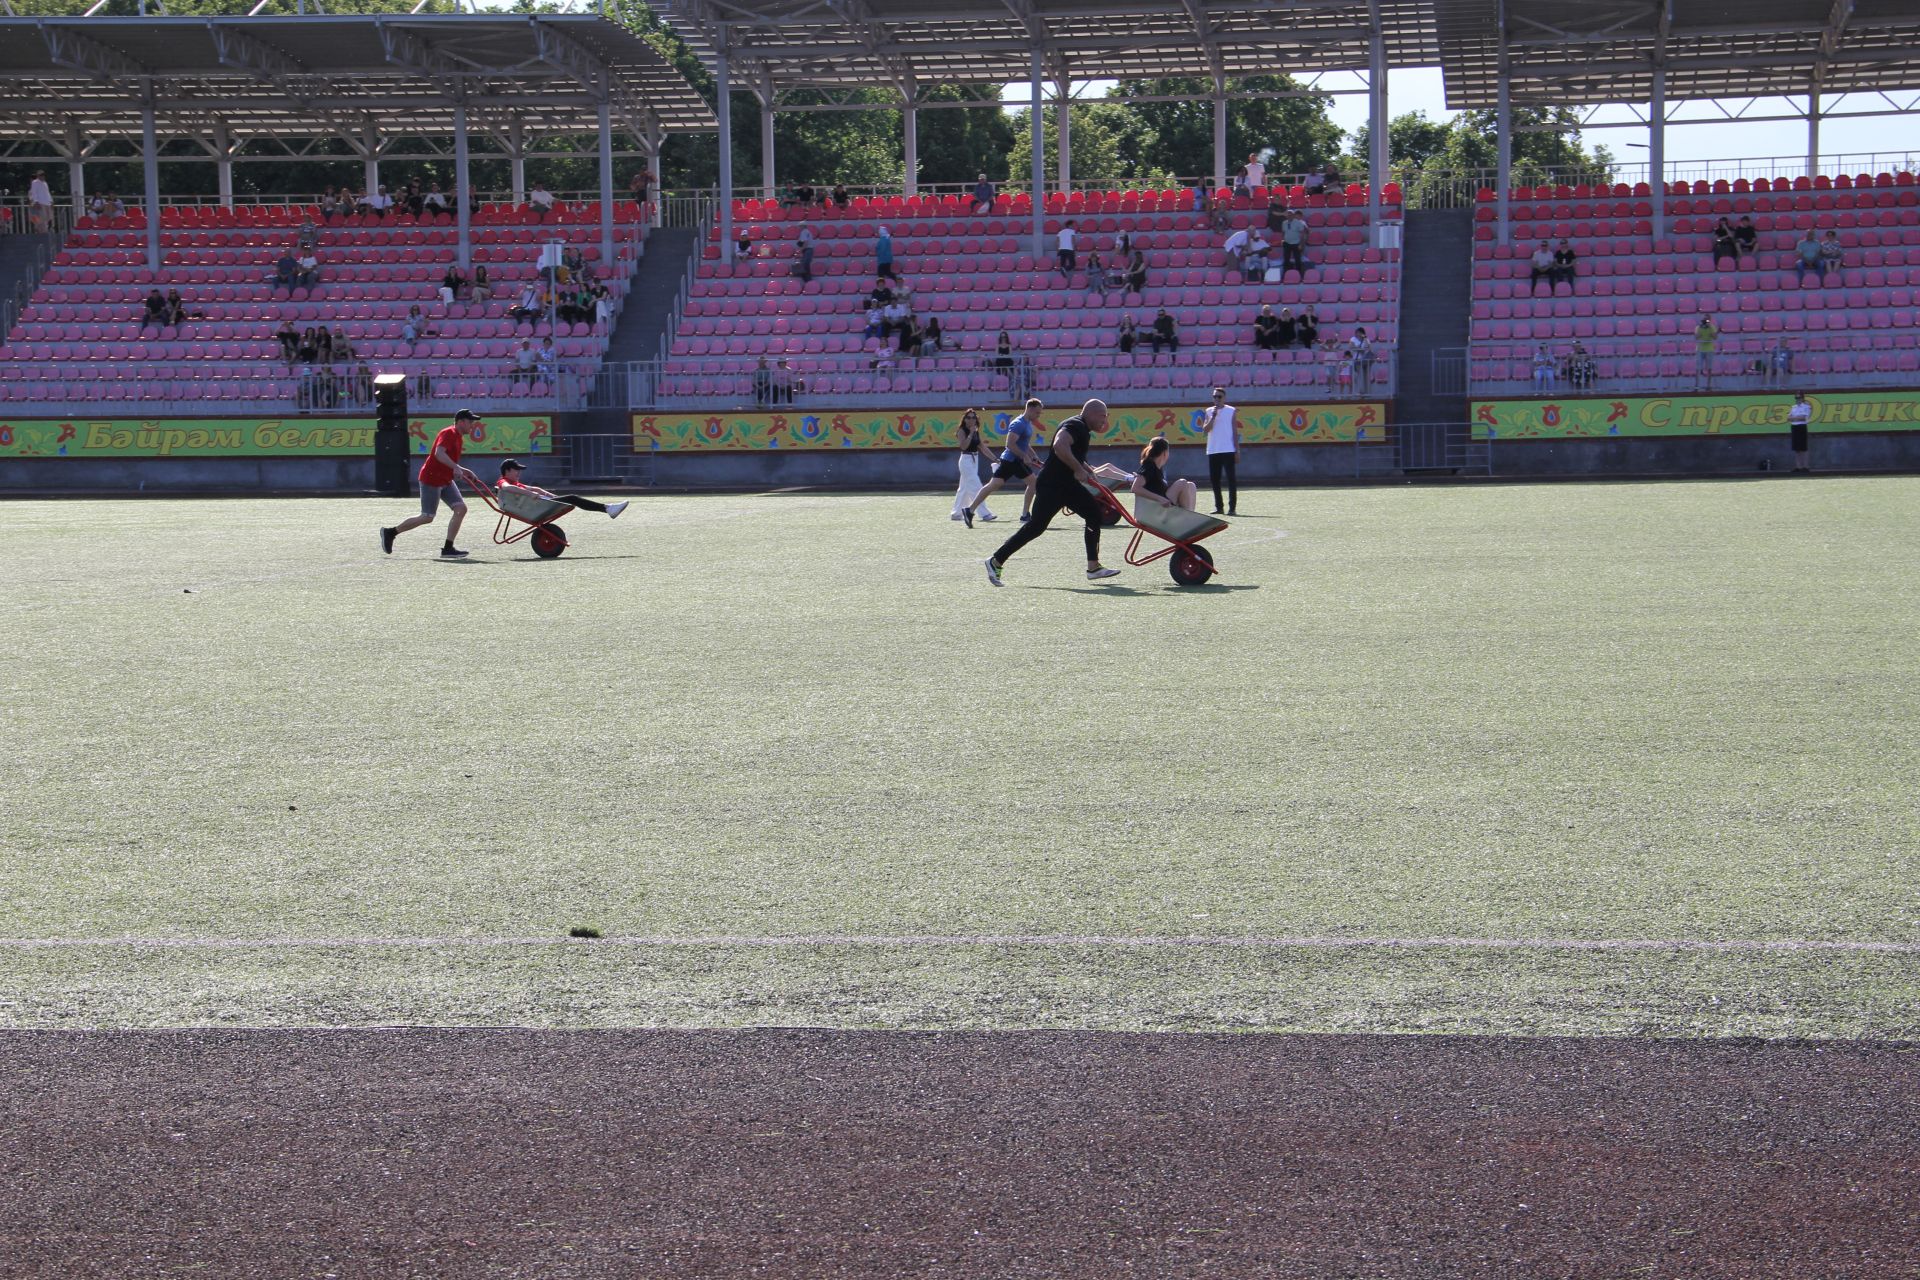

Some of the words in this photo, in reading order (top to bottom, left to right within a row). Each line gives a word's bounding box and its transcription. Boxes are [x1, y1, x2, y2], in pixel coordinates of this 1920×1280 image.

[1640, 399, 1672, 428] С
[83, 421, 244, 455] Бәйрәм
[254, 421, 379, 448] белән
